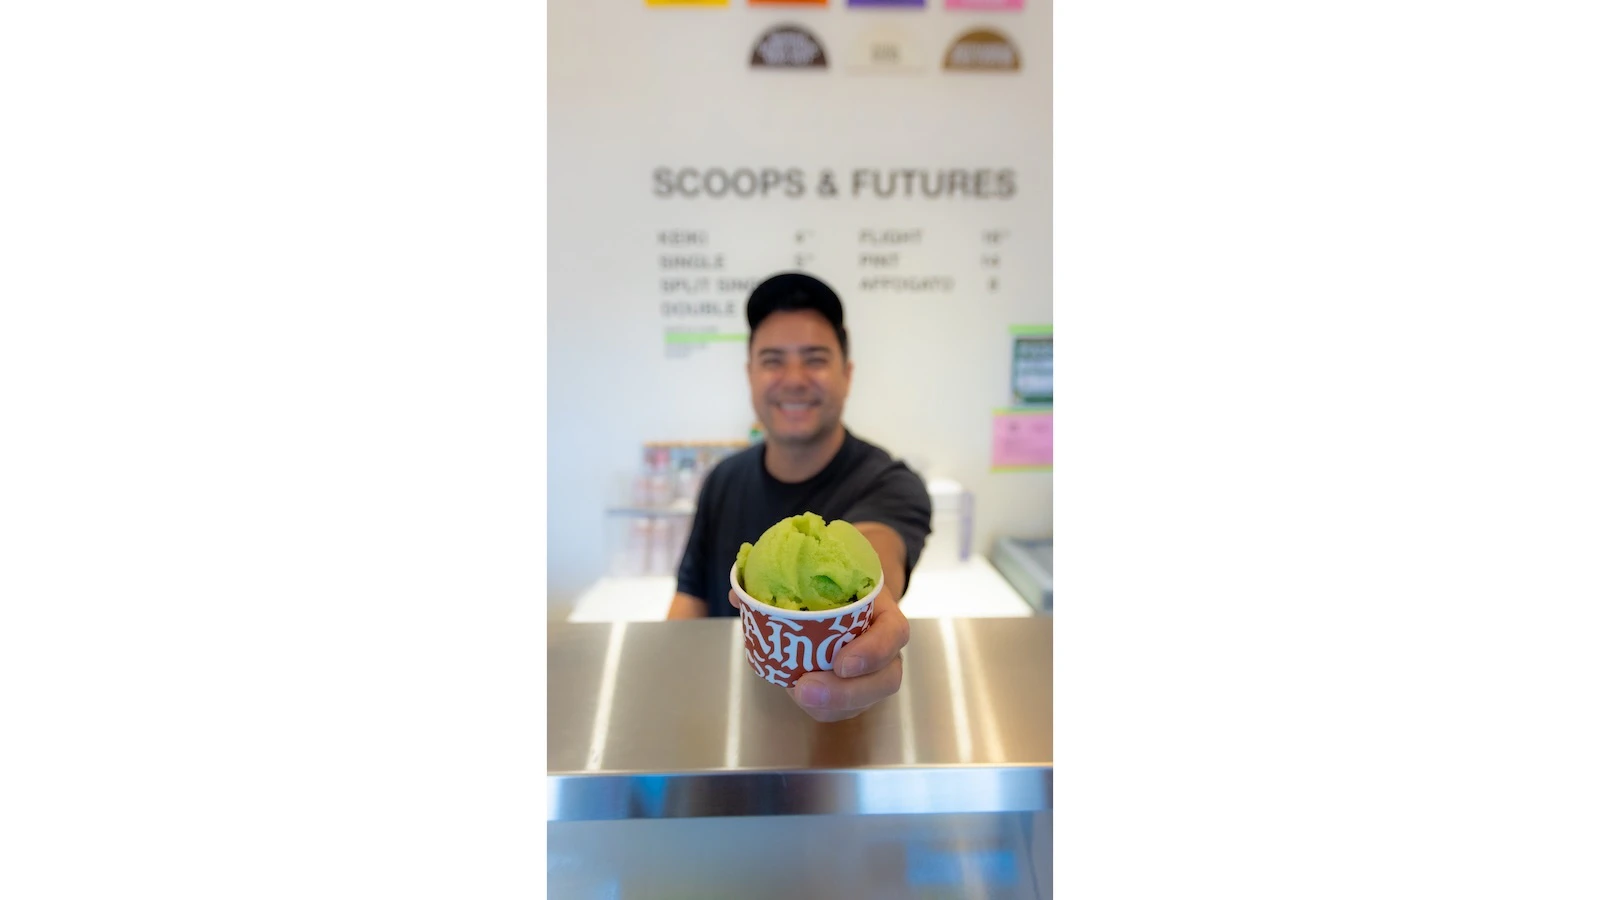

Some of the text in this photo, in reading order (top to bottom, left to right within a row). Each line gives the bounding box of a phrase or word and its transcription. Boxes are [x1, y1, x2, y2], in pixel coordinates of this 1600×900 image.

[652, 168, 1018, 199] SCOOPS & FUTURES
[858, 230, 923, 245] FLIGHT
[659, 254, 725, 269] SINGLE
[858, 254, 899, 268] PINT
[660, 278, 711, 293] SPLIT
[858, 277, 955, 292] AFFOGATO
[661, 301, 735, 317] DOUBLE
